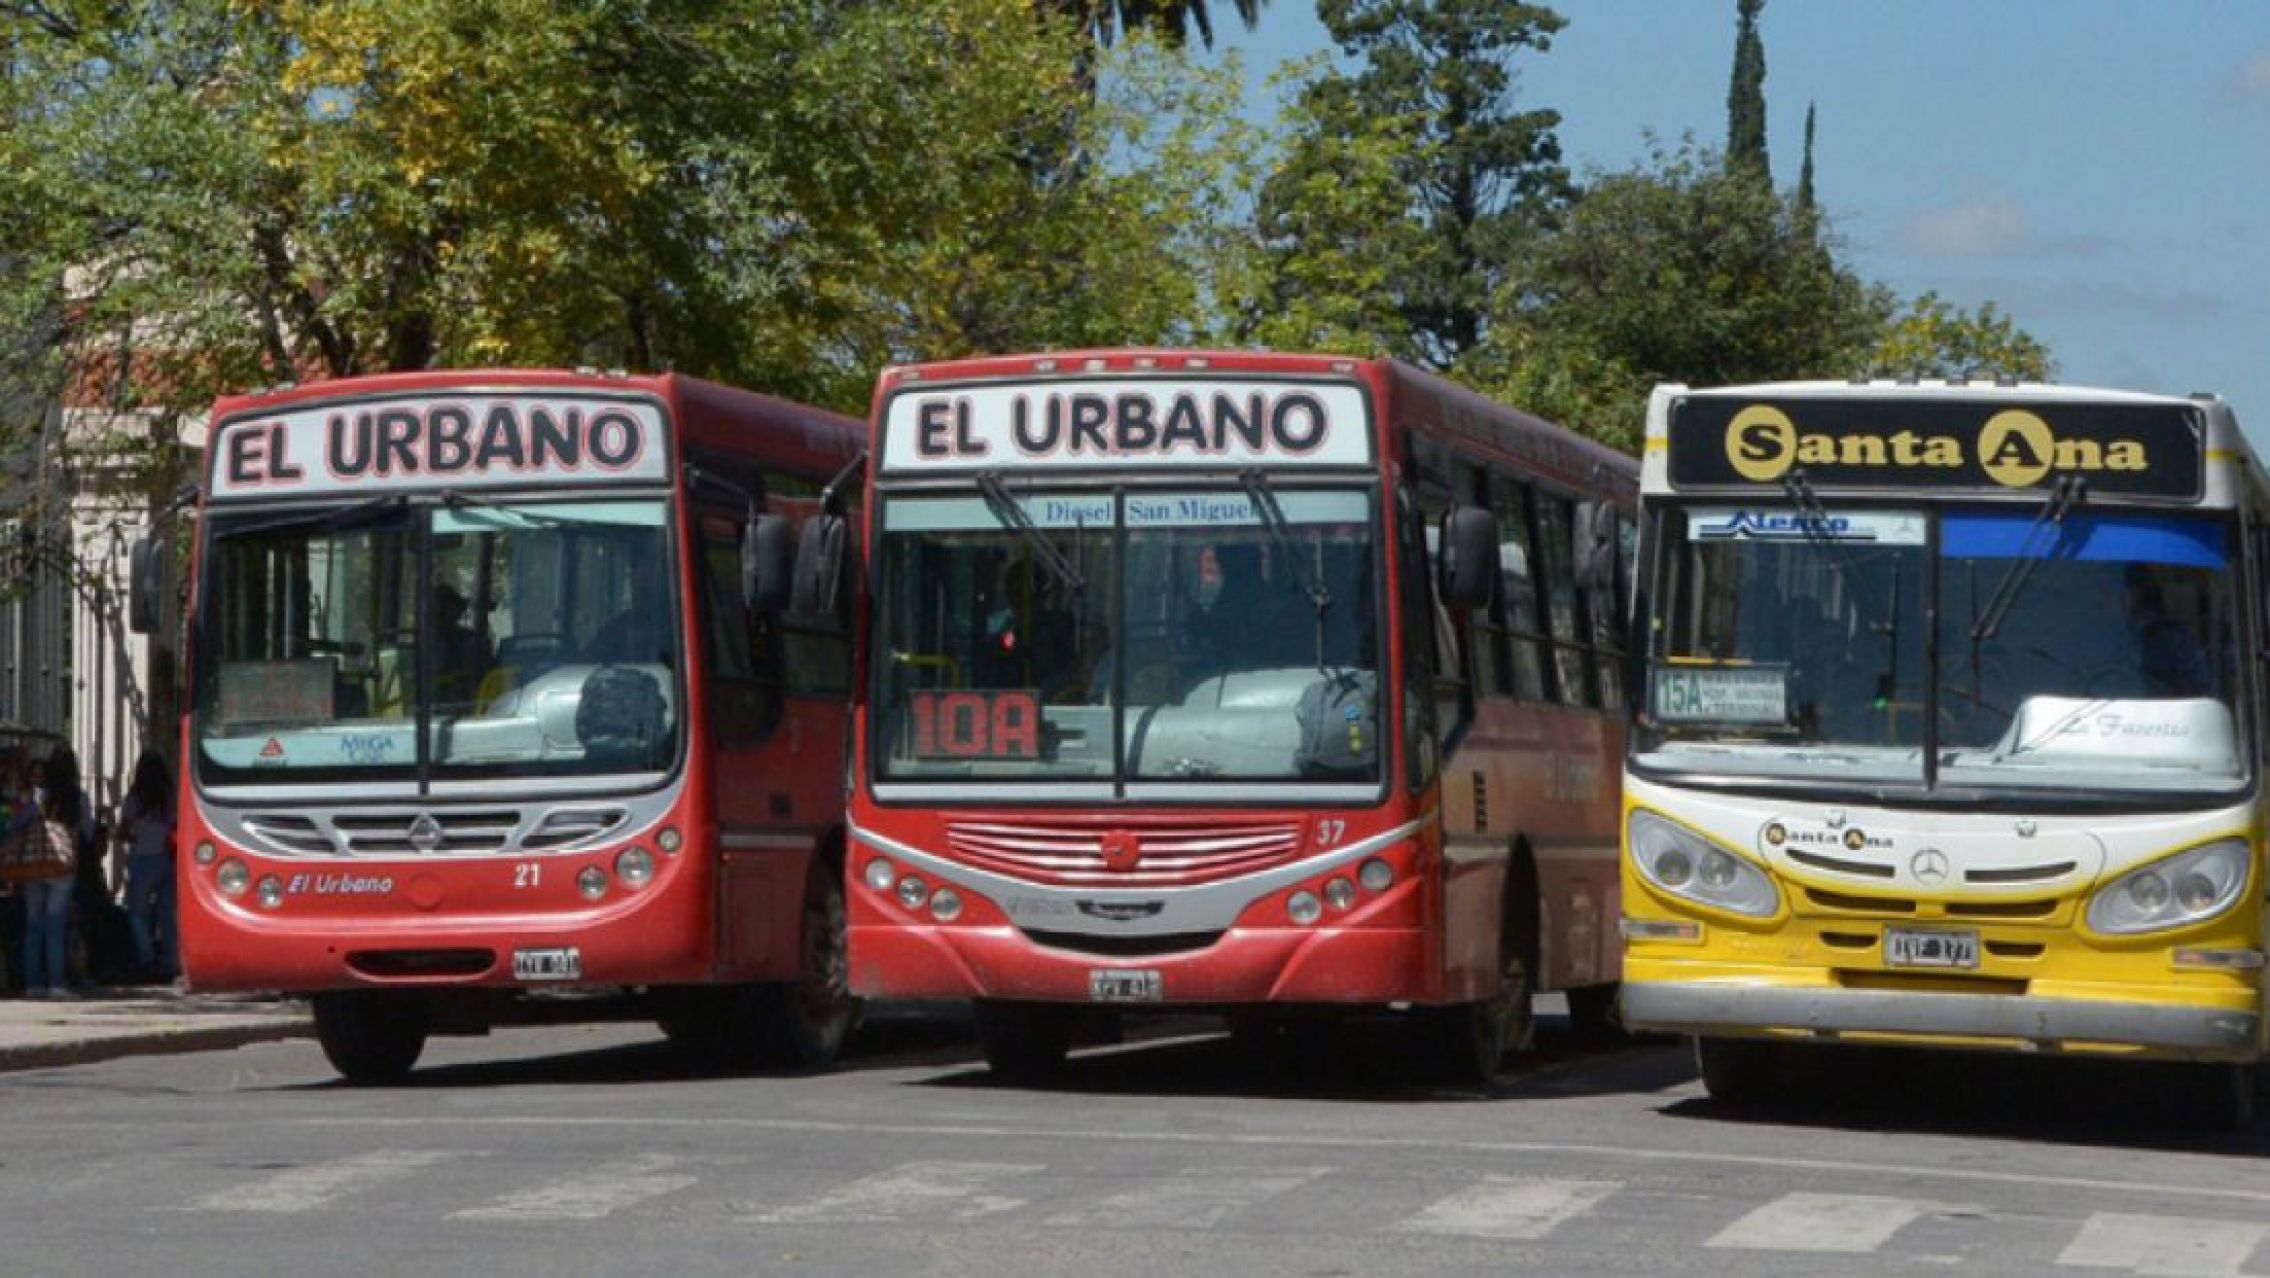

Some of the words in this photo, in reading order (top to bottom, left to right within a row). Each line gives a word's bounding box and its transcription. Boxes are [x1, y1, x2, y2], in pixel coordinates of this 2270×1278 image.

[227, 424, 304, 486] EL
[328, 402, 643, 478] URBANO
[917, 400, 987, 457] EL
[1012, 391, 1329, 455] URBANO
[1733, 416, 1964, 471] Santa
[1982, 422, 2149, 474] Ana
[1047, 500, 1110, 522] Diesel
[1129, 500, 1170, 521] San
[1661, 671, 1703, 714] 15A
[912, 689, 1039, 759] 10A
[1316, 818, 1346, 846] 37
[288, 873, 309, 894] El
[314, 872, 393, 895] Urbano
[513, 862, 541, 889] 21
